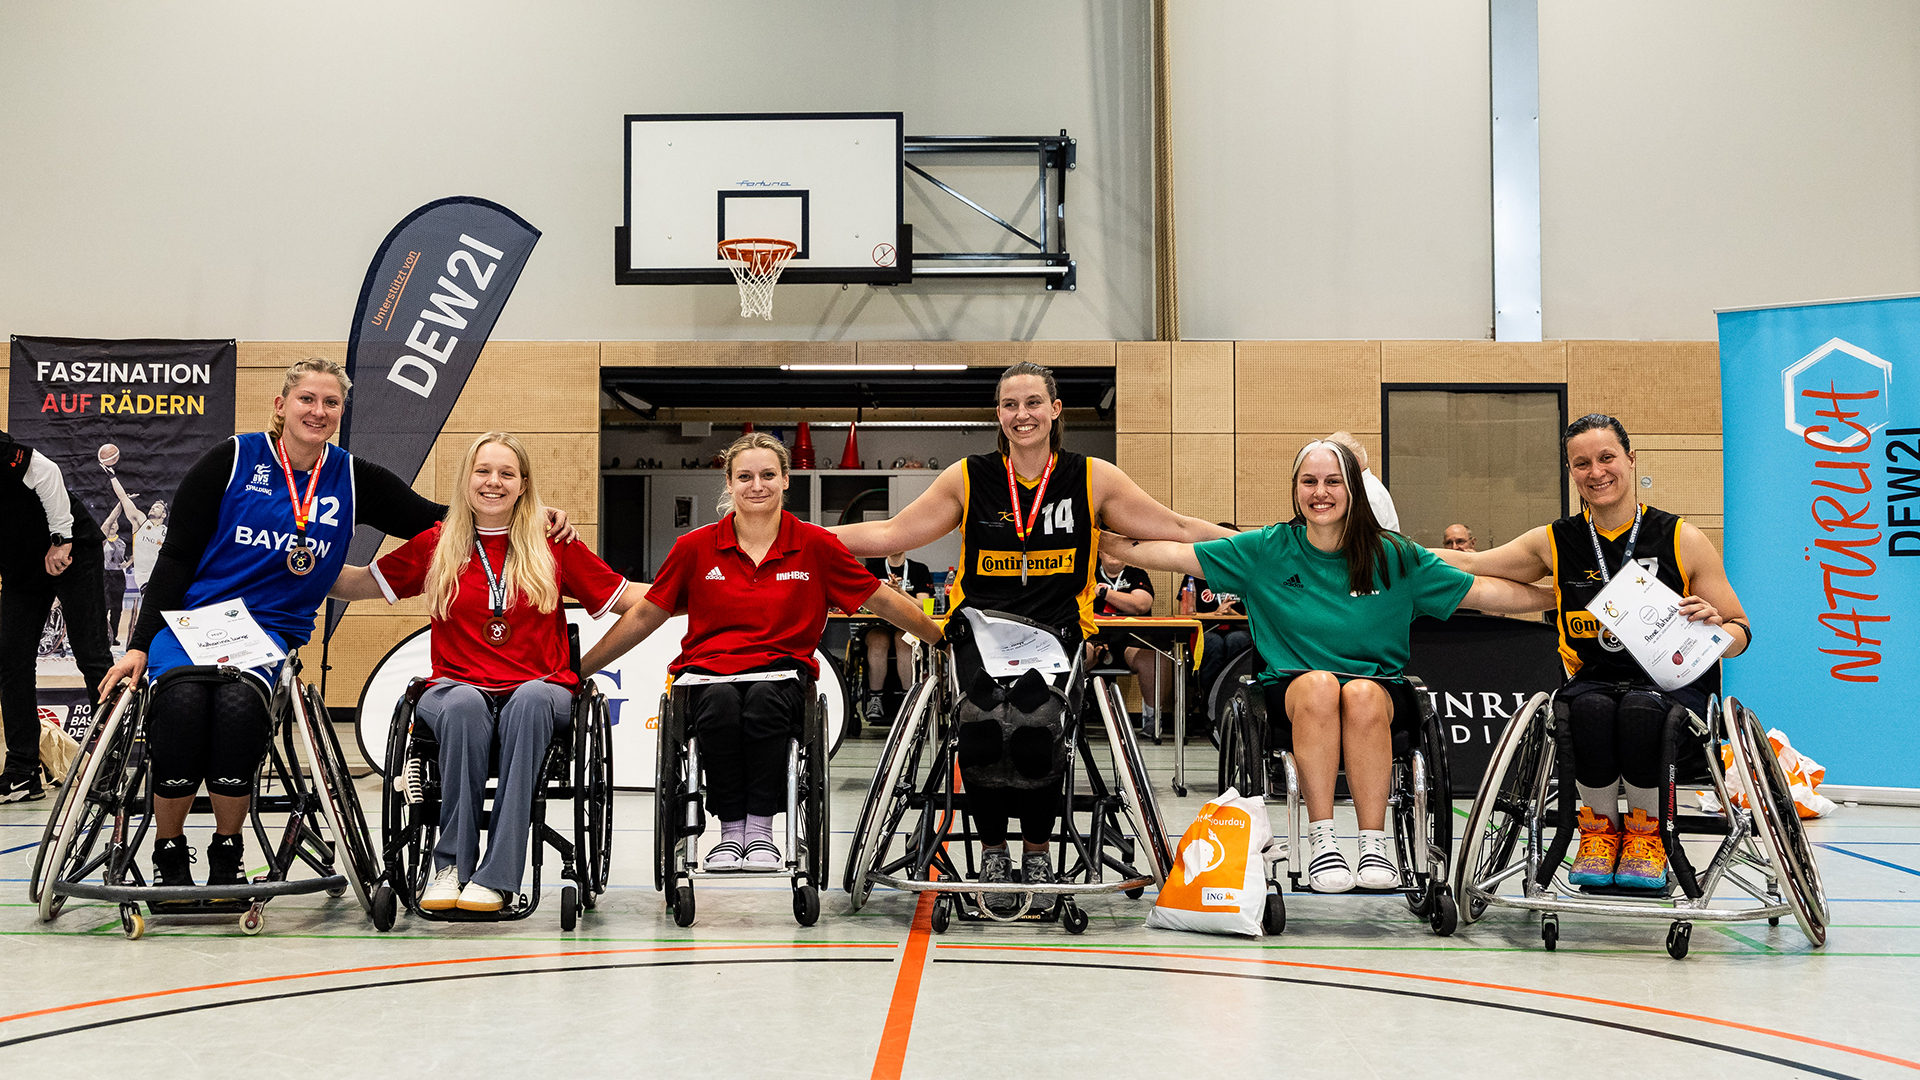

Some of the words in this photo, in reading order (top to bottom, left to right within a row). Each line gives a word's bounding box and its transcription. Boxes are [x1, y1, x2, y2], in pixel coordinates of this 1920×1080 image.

[736, 179, 791, 187] fortuna
[371, 269, 407, 326] Unterstützt
[402, 250, 418, 269] von
[36, 361, 210, 384] FASZINATION
[41, 393, 92, 413] AUF
[100, 389, 205, 415] RÄDERN
[252, 473, 270, 483] BVS
[245, 484, 272, 496] SPALDING
[307, 495, 340, 527] 12
[1041, 497, 1075, 535] 14
[234, 525, 332, 559] BAYERN
[981, 554, 1064, 573] Continental
[1206, 893, 1224, 901] ING
